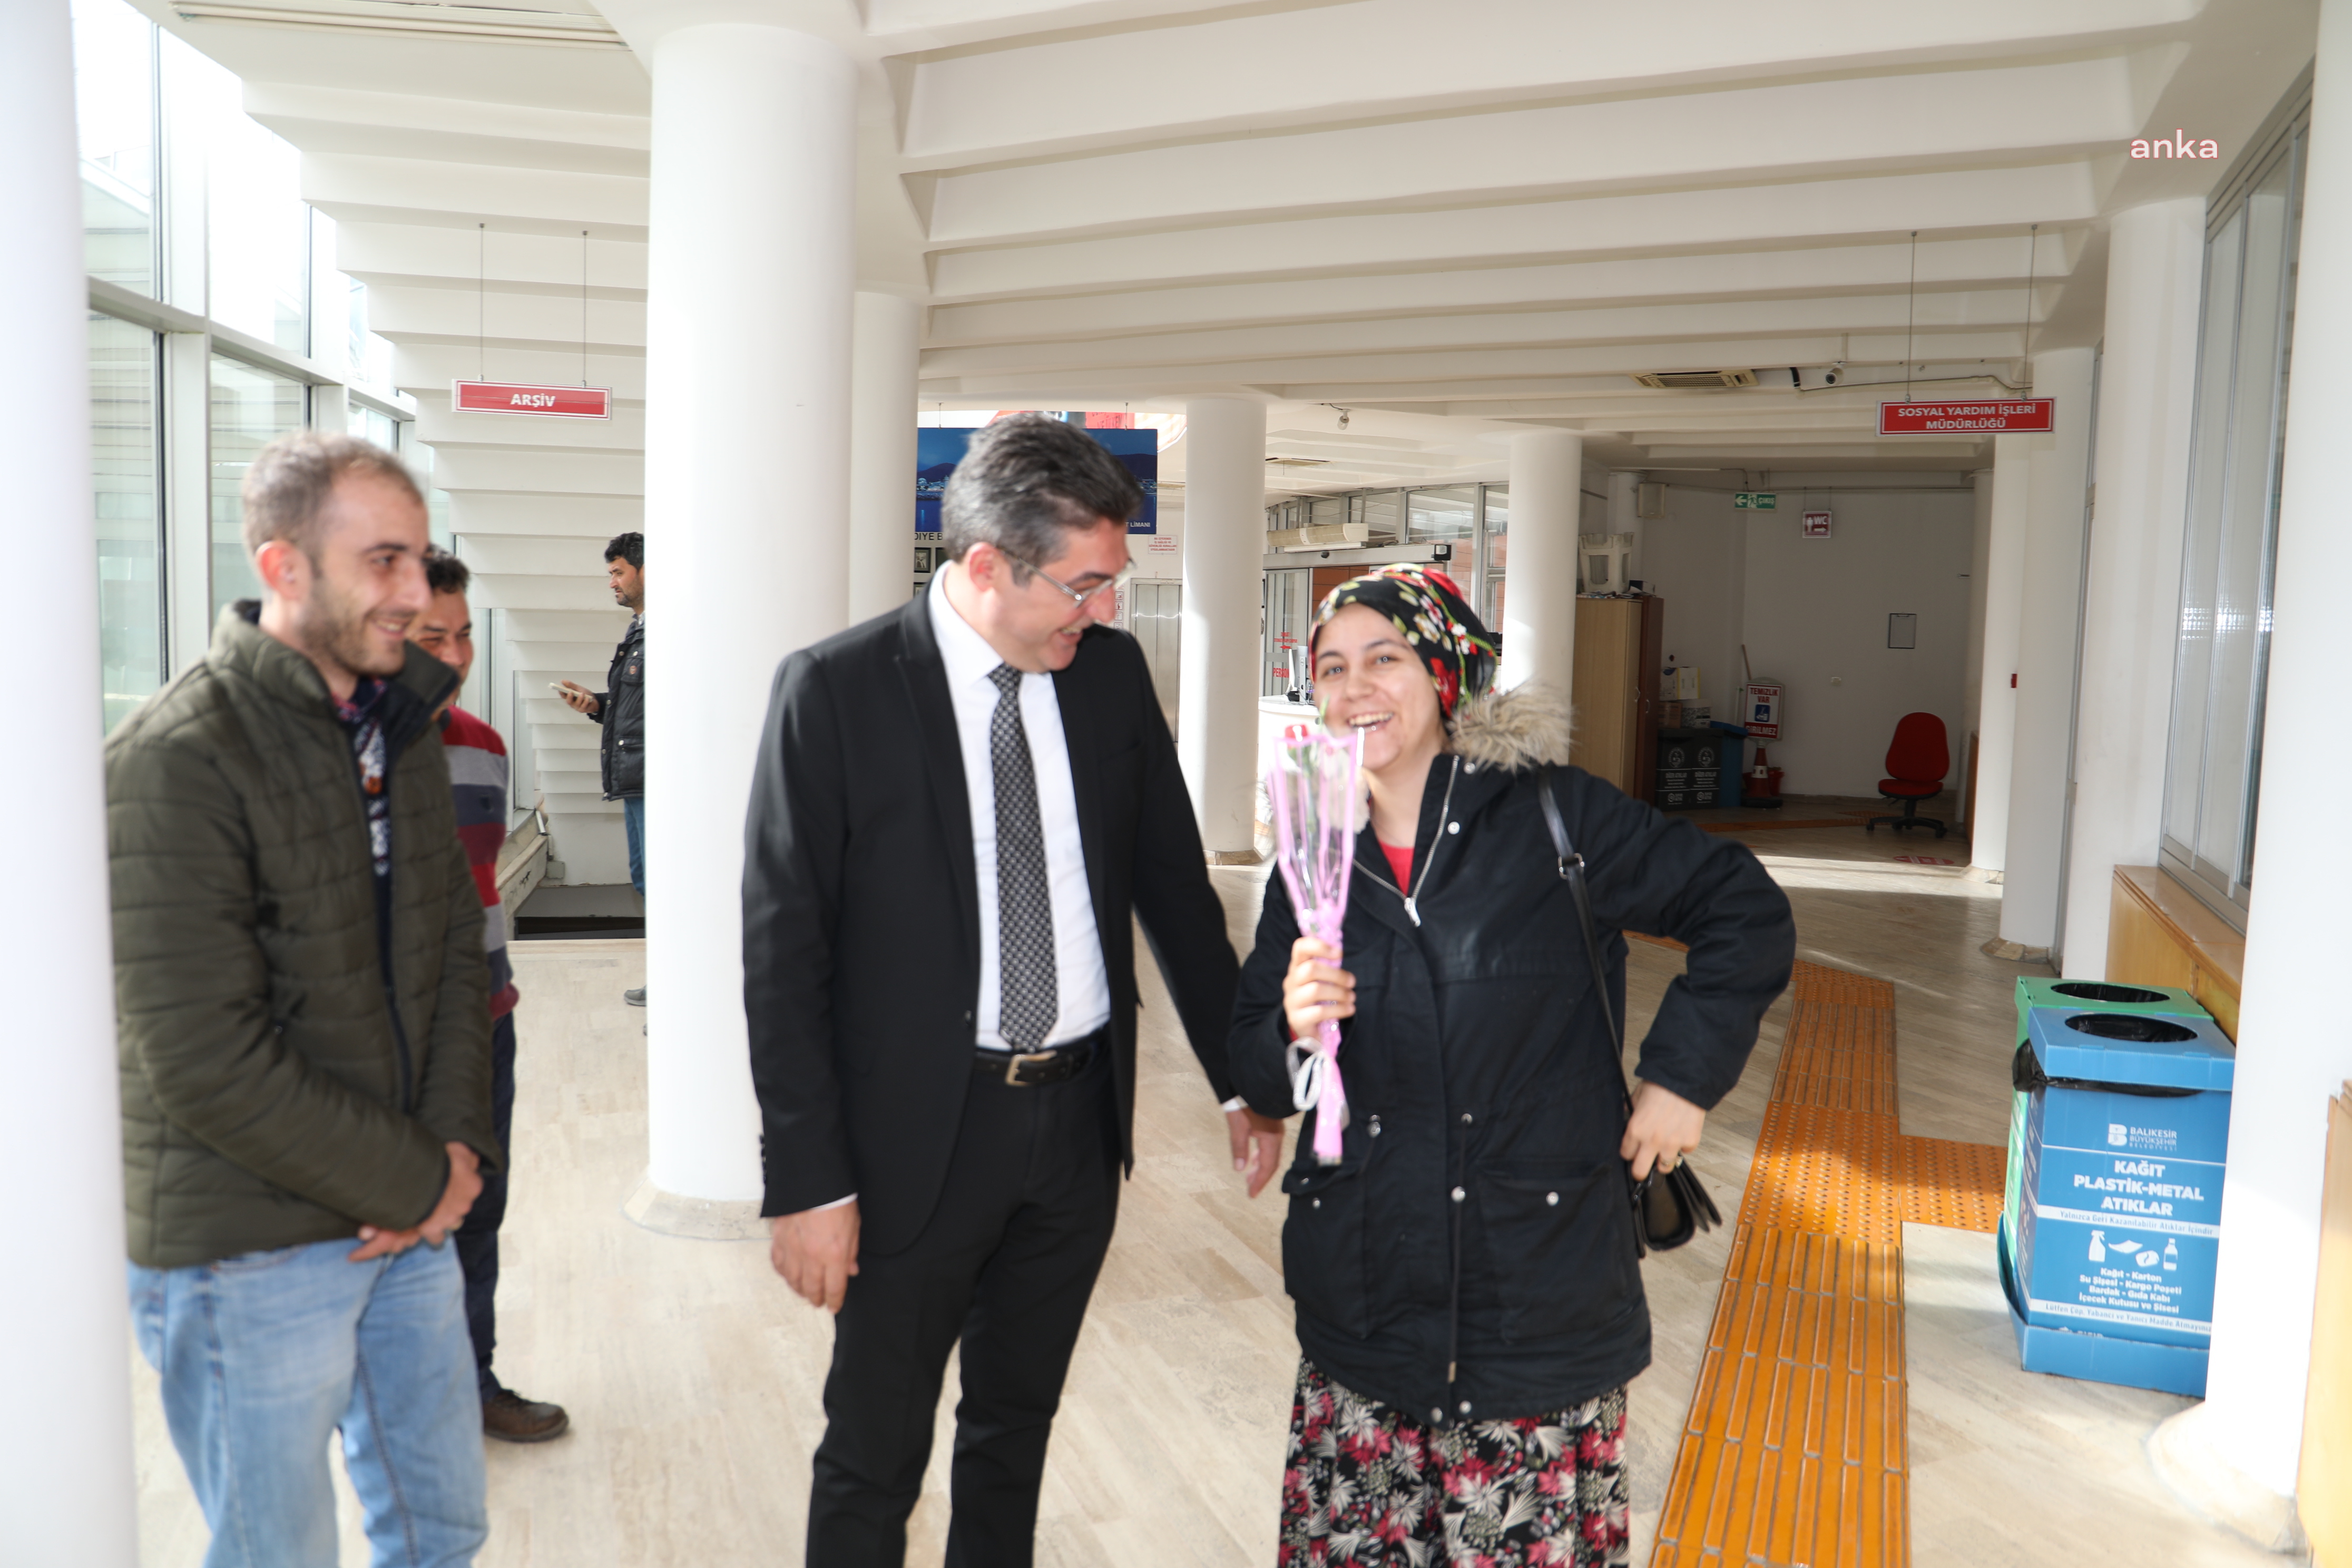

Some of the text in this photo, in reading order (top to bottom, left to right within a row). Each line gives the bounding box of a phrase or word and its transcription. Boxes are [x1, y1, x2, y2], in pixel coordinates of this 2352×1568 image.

[510, 393, 556, 407] ARŞİV
[1898, 403, 2036, 417] SOSYAL YARDIM İŞLERİ
[1926, 418, 2006, 429] MÜDÜRLÜĞÜ
[1814, 516, 1828, 525] WC
[1750, 688, 1779, 696] TEMİZLİK
[2130, 1126, 2177, 1139] BALIKESİR
[2114, 1160, 2165, 1178] KAĞIT
[2074, 1174, 2204, 1201] PLASTİK-METAL
[2101, 1196, 2173, 1216] ATIKLAR
[2060, 1210, 2090, 1221] Yalnızca
[2092, 1212, 2108, 1222] Geri
[2110, 1216, 2157, 1229] Kazanılabilir
[2100, 1267, 2124, 1278] Kağıt
[2131, 1271, 2162, 1282] Karton
[2080, 1274, 2091, 1283] Su
[2093, 1276, 2118, 1287] Şişesi
[2125, 1280, 2152, 1291] Kargo
[2153, 1283, 2182, 1295] Poşeti
[2079, 1292, 2107, 1304] İçecek
[2109, 1297, 2139, 1308] Kutusu
[2089, 1285, 2120, 1296] Bardak
[2128, 1290, 2148, 1300] Gıda
[2150, 1292, 2170, 1303] Kabı
[2046, 1303, 2068, 1313] Lütfen
